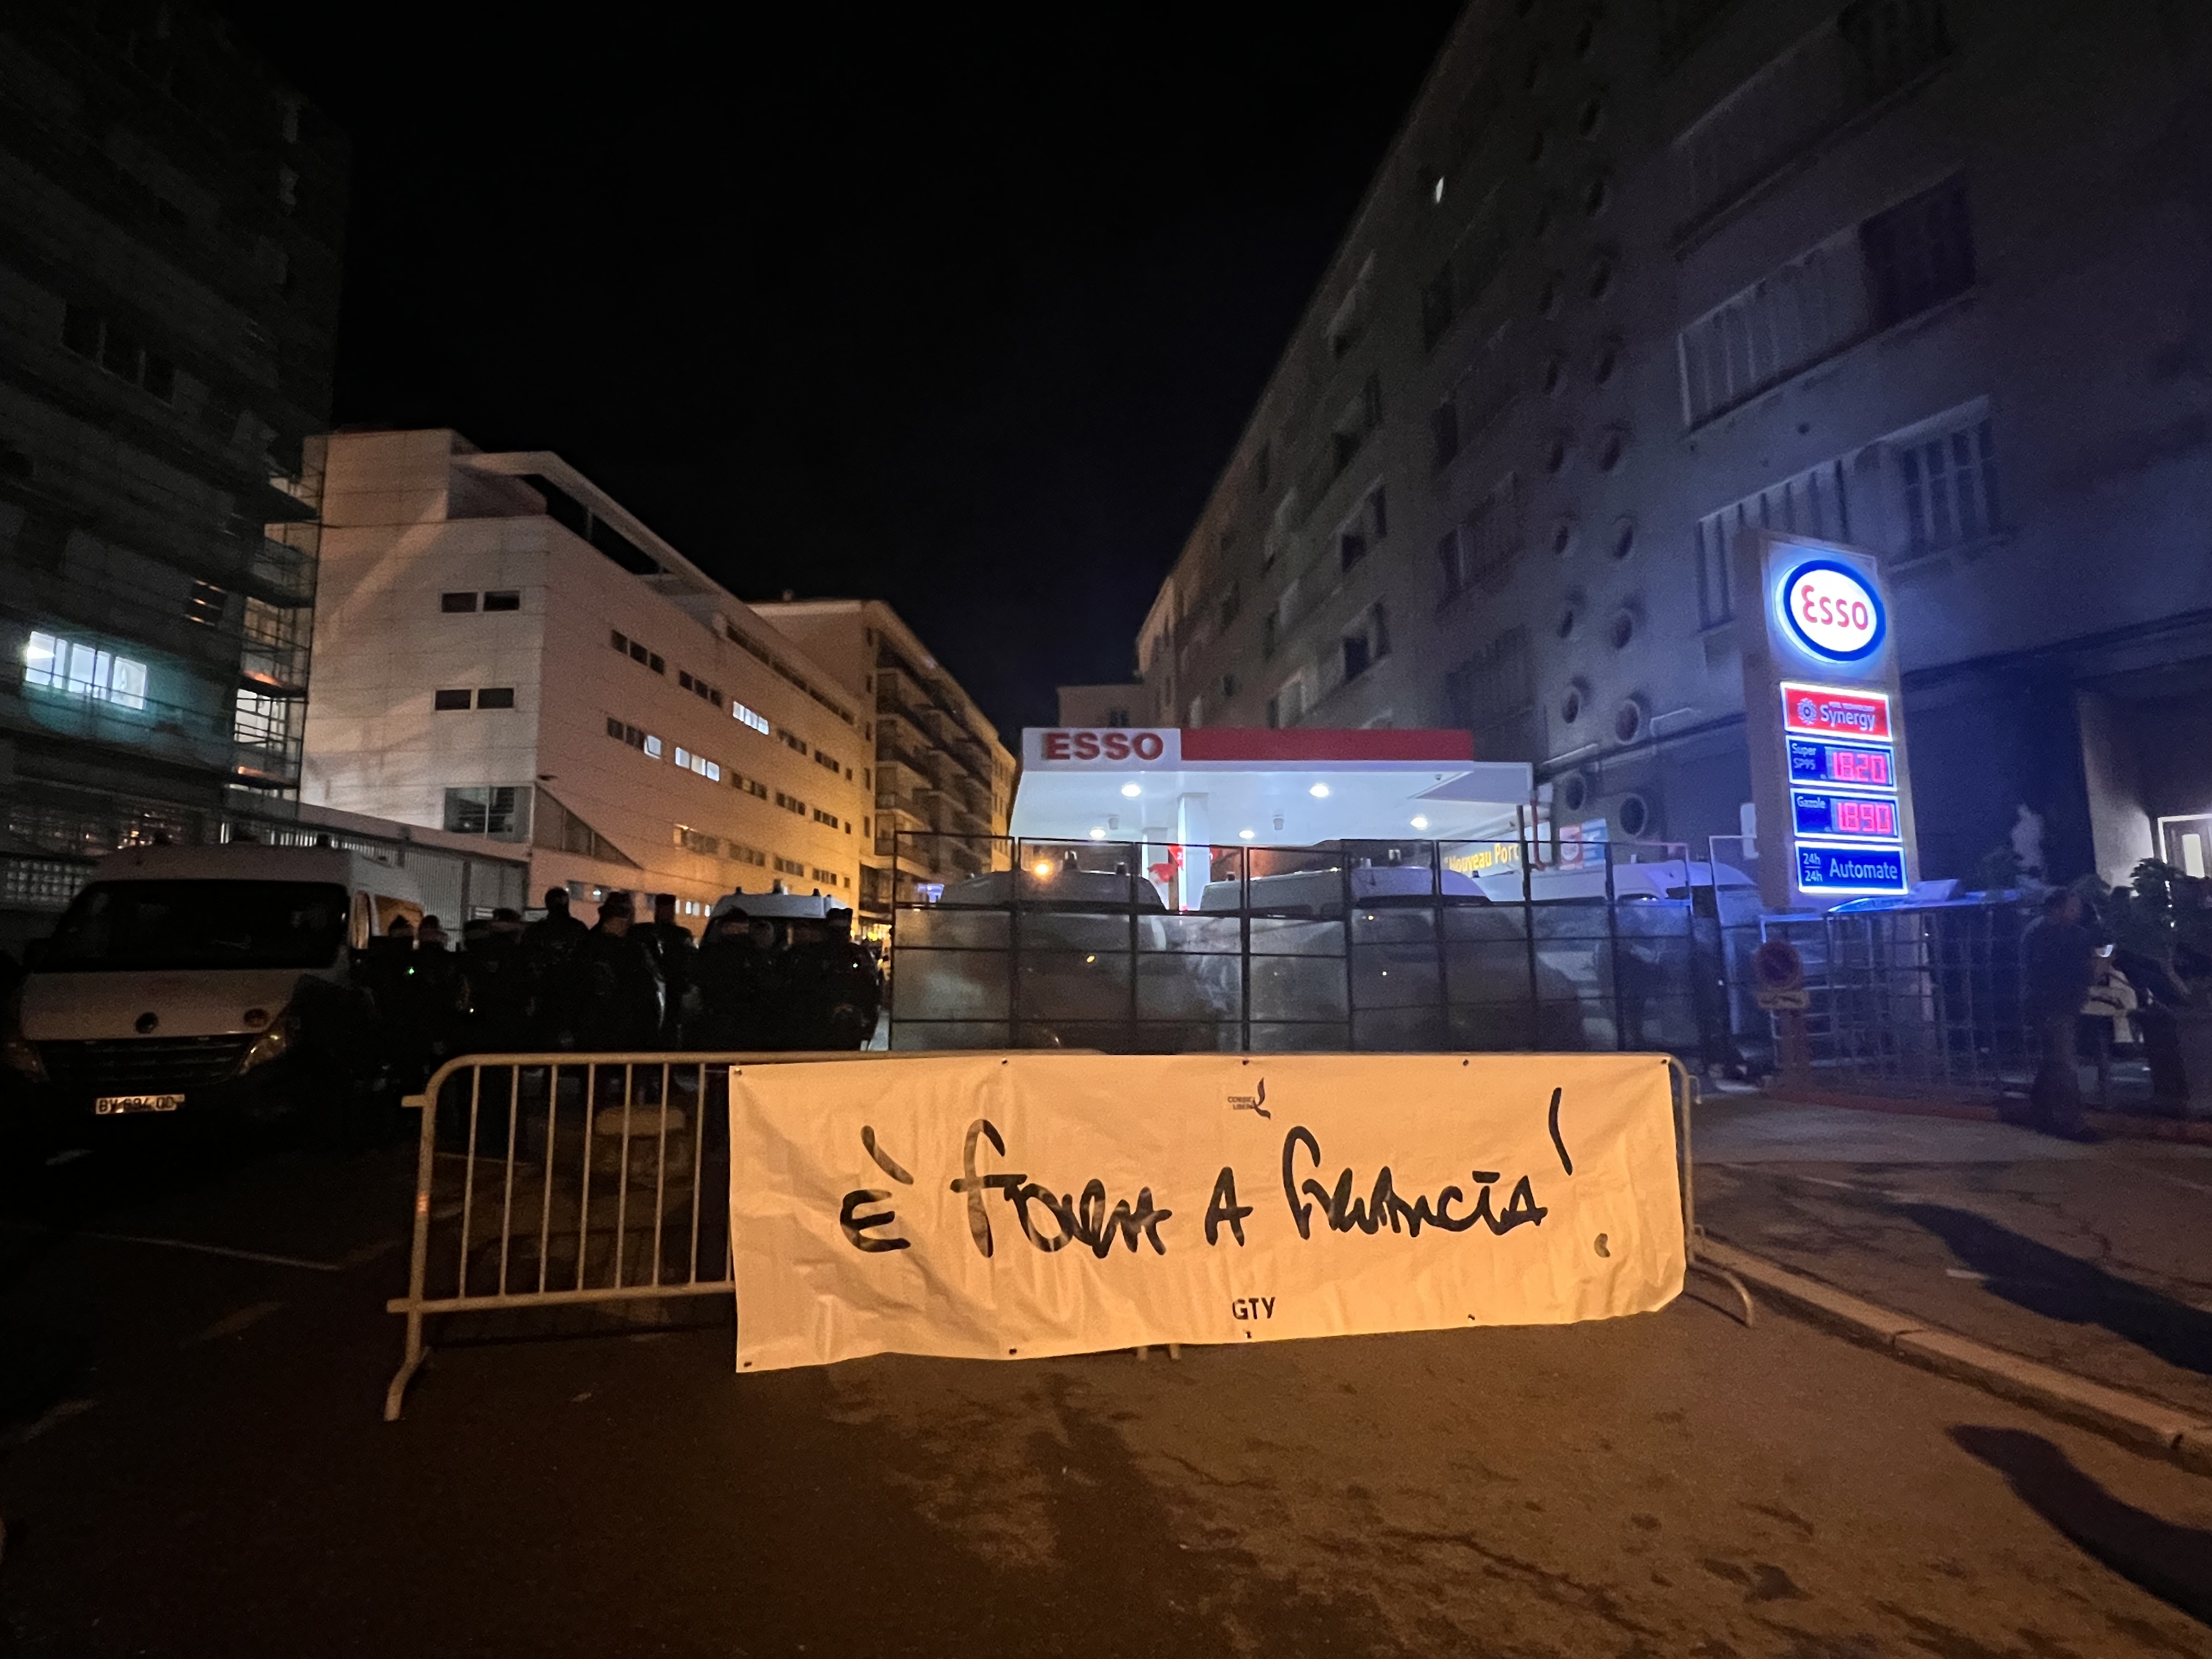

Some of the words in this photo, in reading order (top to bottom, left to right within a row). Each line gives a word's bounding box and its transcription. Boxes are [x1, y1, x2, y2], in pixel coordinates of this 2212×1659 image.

[1801, 585, 1868, 630] Esso
[1820, 704, 1876, 732] Synergy
[1046, 732, 1164, 760] ESSO
[1803, 853, 1821, 865] 24h
[1830, 858, 1898, 879] Automate
[1805, 870, 1822, 882] 24h
